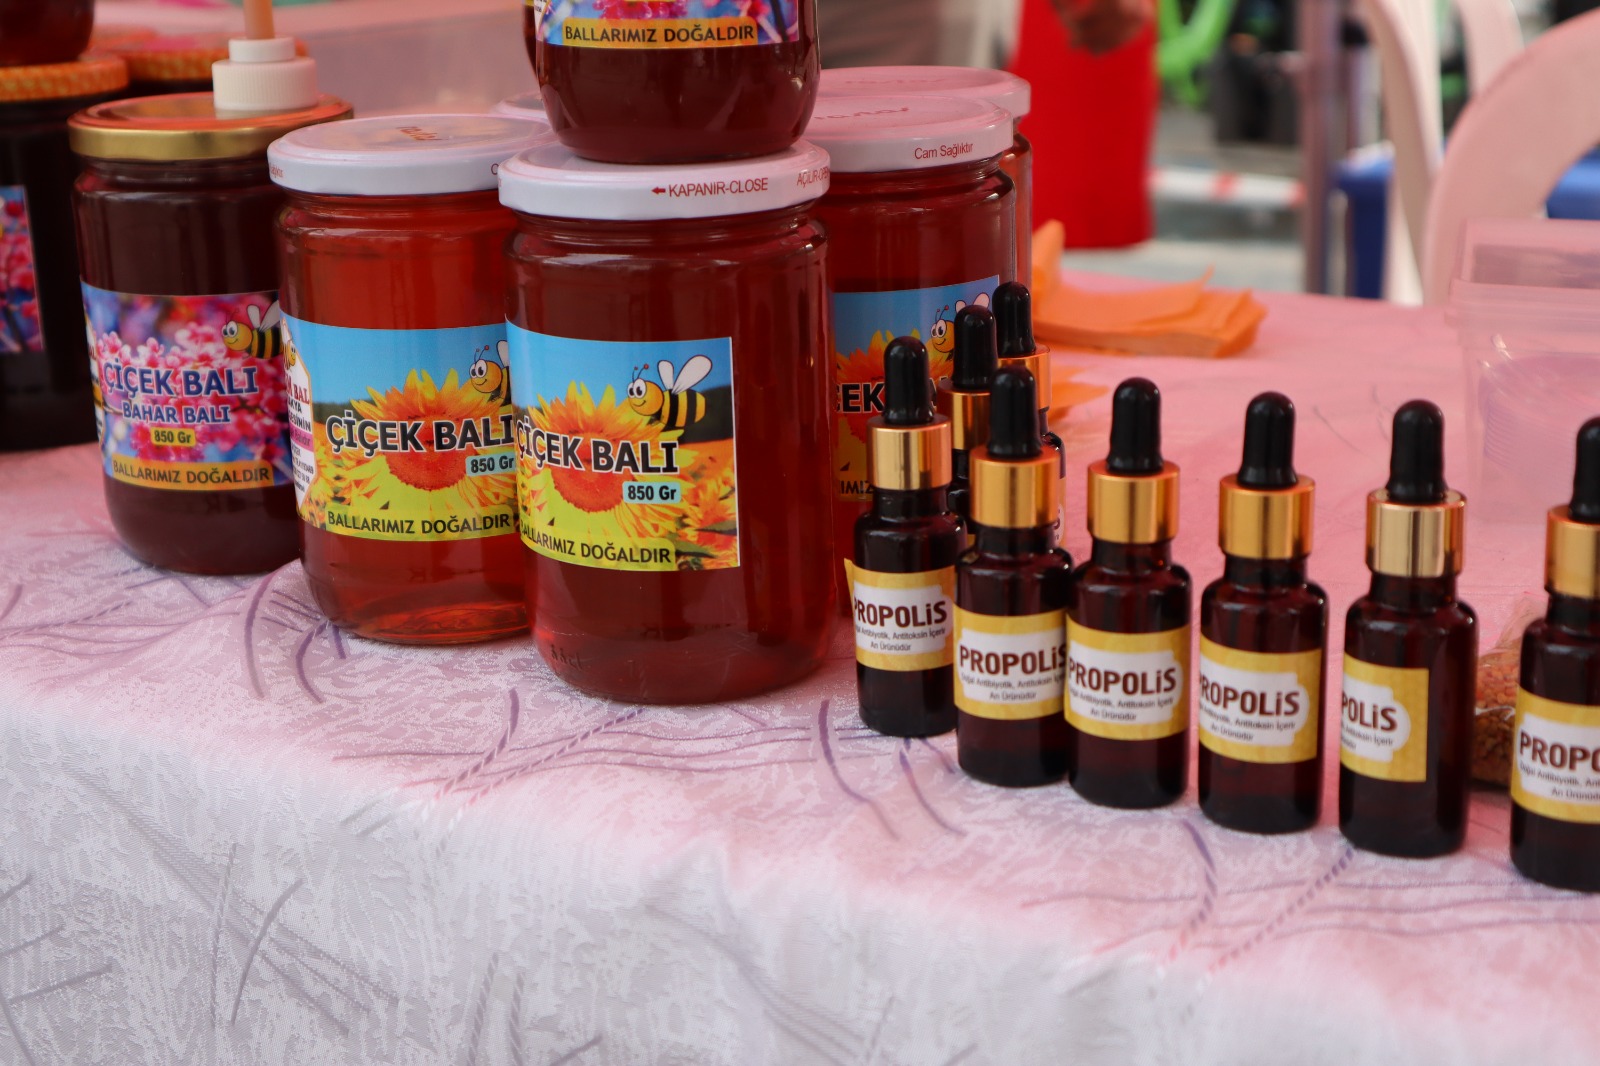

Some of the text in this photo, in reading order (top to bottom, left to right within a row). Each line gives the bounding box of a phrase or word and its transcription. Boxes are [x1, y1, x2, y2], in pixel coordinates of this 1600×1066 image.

[565, 24, 754, 42] BALLARIMIZ DOĞALDIR
[914, 148, 938, 160] Cam
[669, 177, 769, 197] KAPANIR-CLOSE
[103, 359, 174, 398] ÇİÇEK
[183, 366, 258, 396] BALI
[837, 382, 885, 413] EK
[123, 402, 231, 424] BAHAR BALI
[154, 430, 191, 444] 850 Gr
[326, 410, 513, 457] ÇİÇEK BALI
[516, 415, 679, 474] ÇİÇEK BALI
[113, 460, 181, 484] BALLARIMIZ
[187, 468, 270, 485] DOĞALDIR
[470, 455, 514, 474] 850 Gr
[628, 485, 677, 501] 850 Gr
[327, 510, 511, 534] BALLARIMIZ DOĞALDIR
[581, 542, 671, 563] DOĞALDIR
